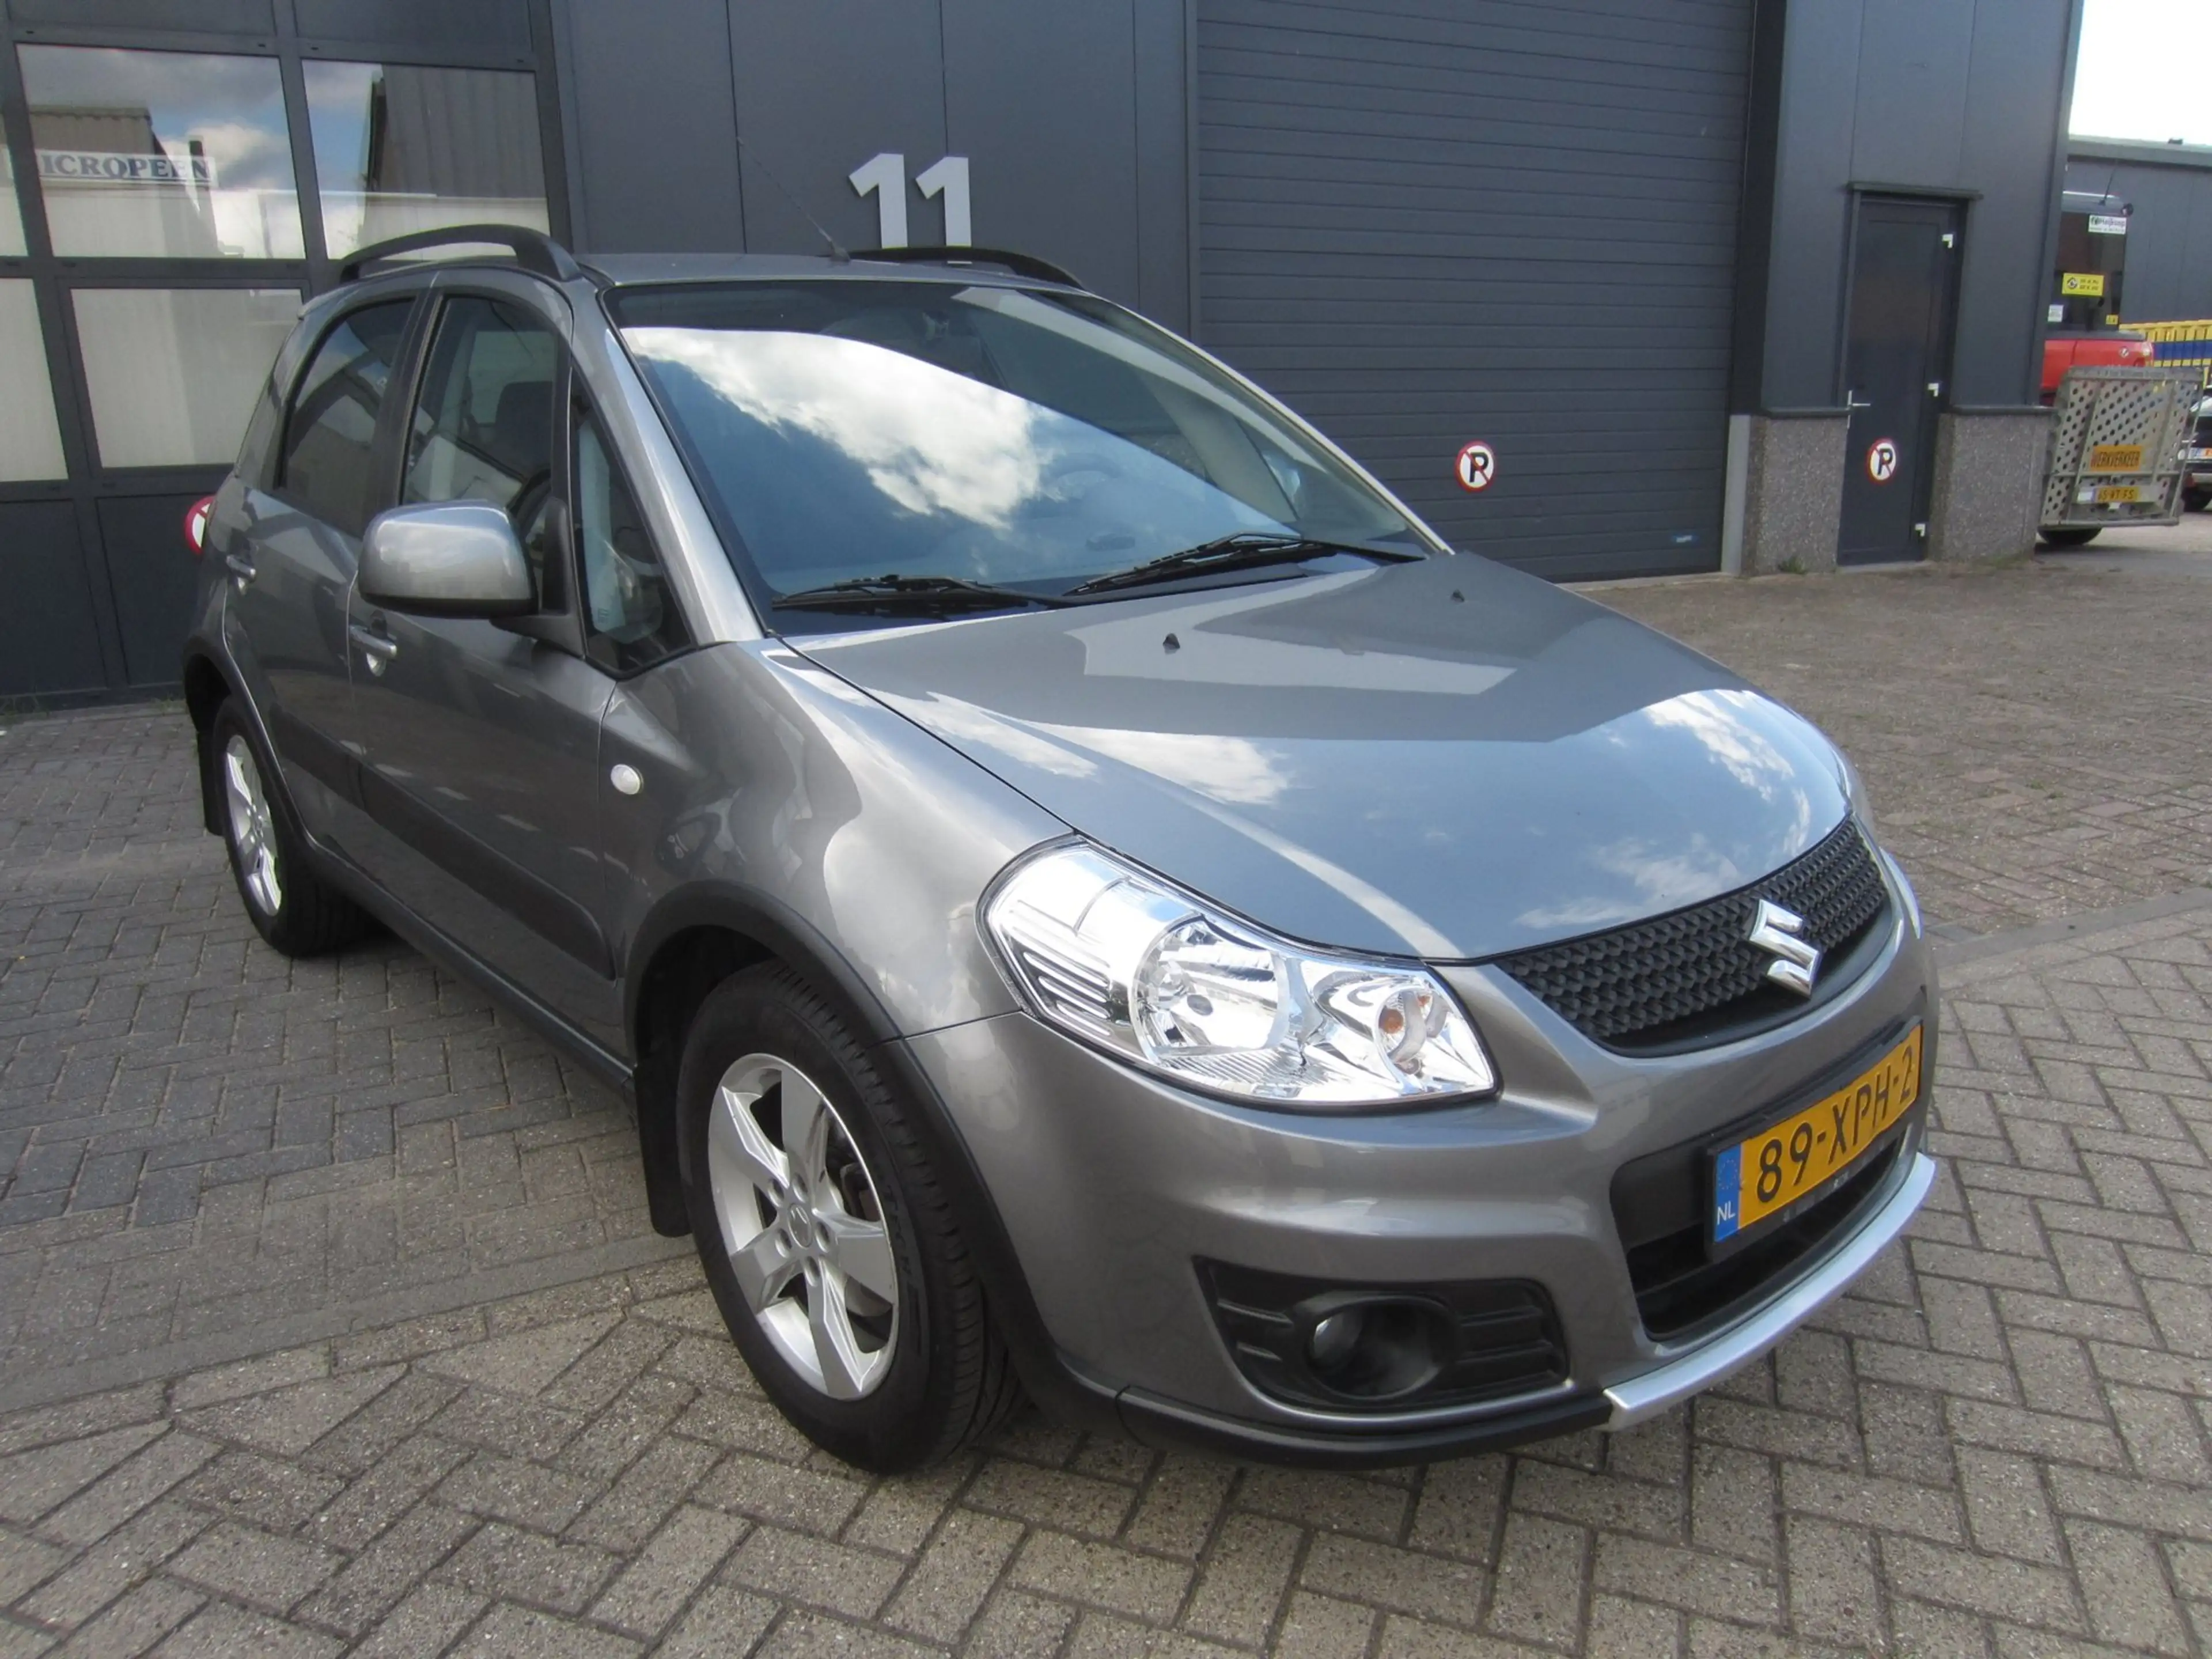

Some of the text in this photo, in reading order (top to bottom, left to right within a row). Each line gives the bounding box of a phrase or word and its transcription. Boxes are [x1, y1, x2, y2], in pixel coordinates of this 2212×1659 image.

[849, 153, 972, 249] 11
[1757, 1046, 1912, 1203] 89-XPH-2
[1717, 1200, 1736, 1225] NL
